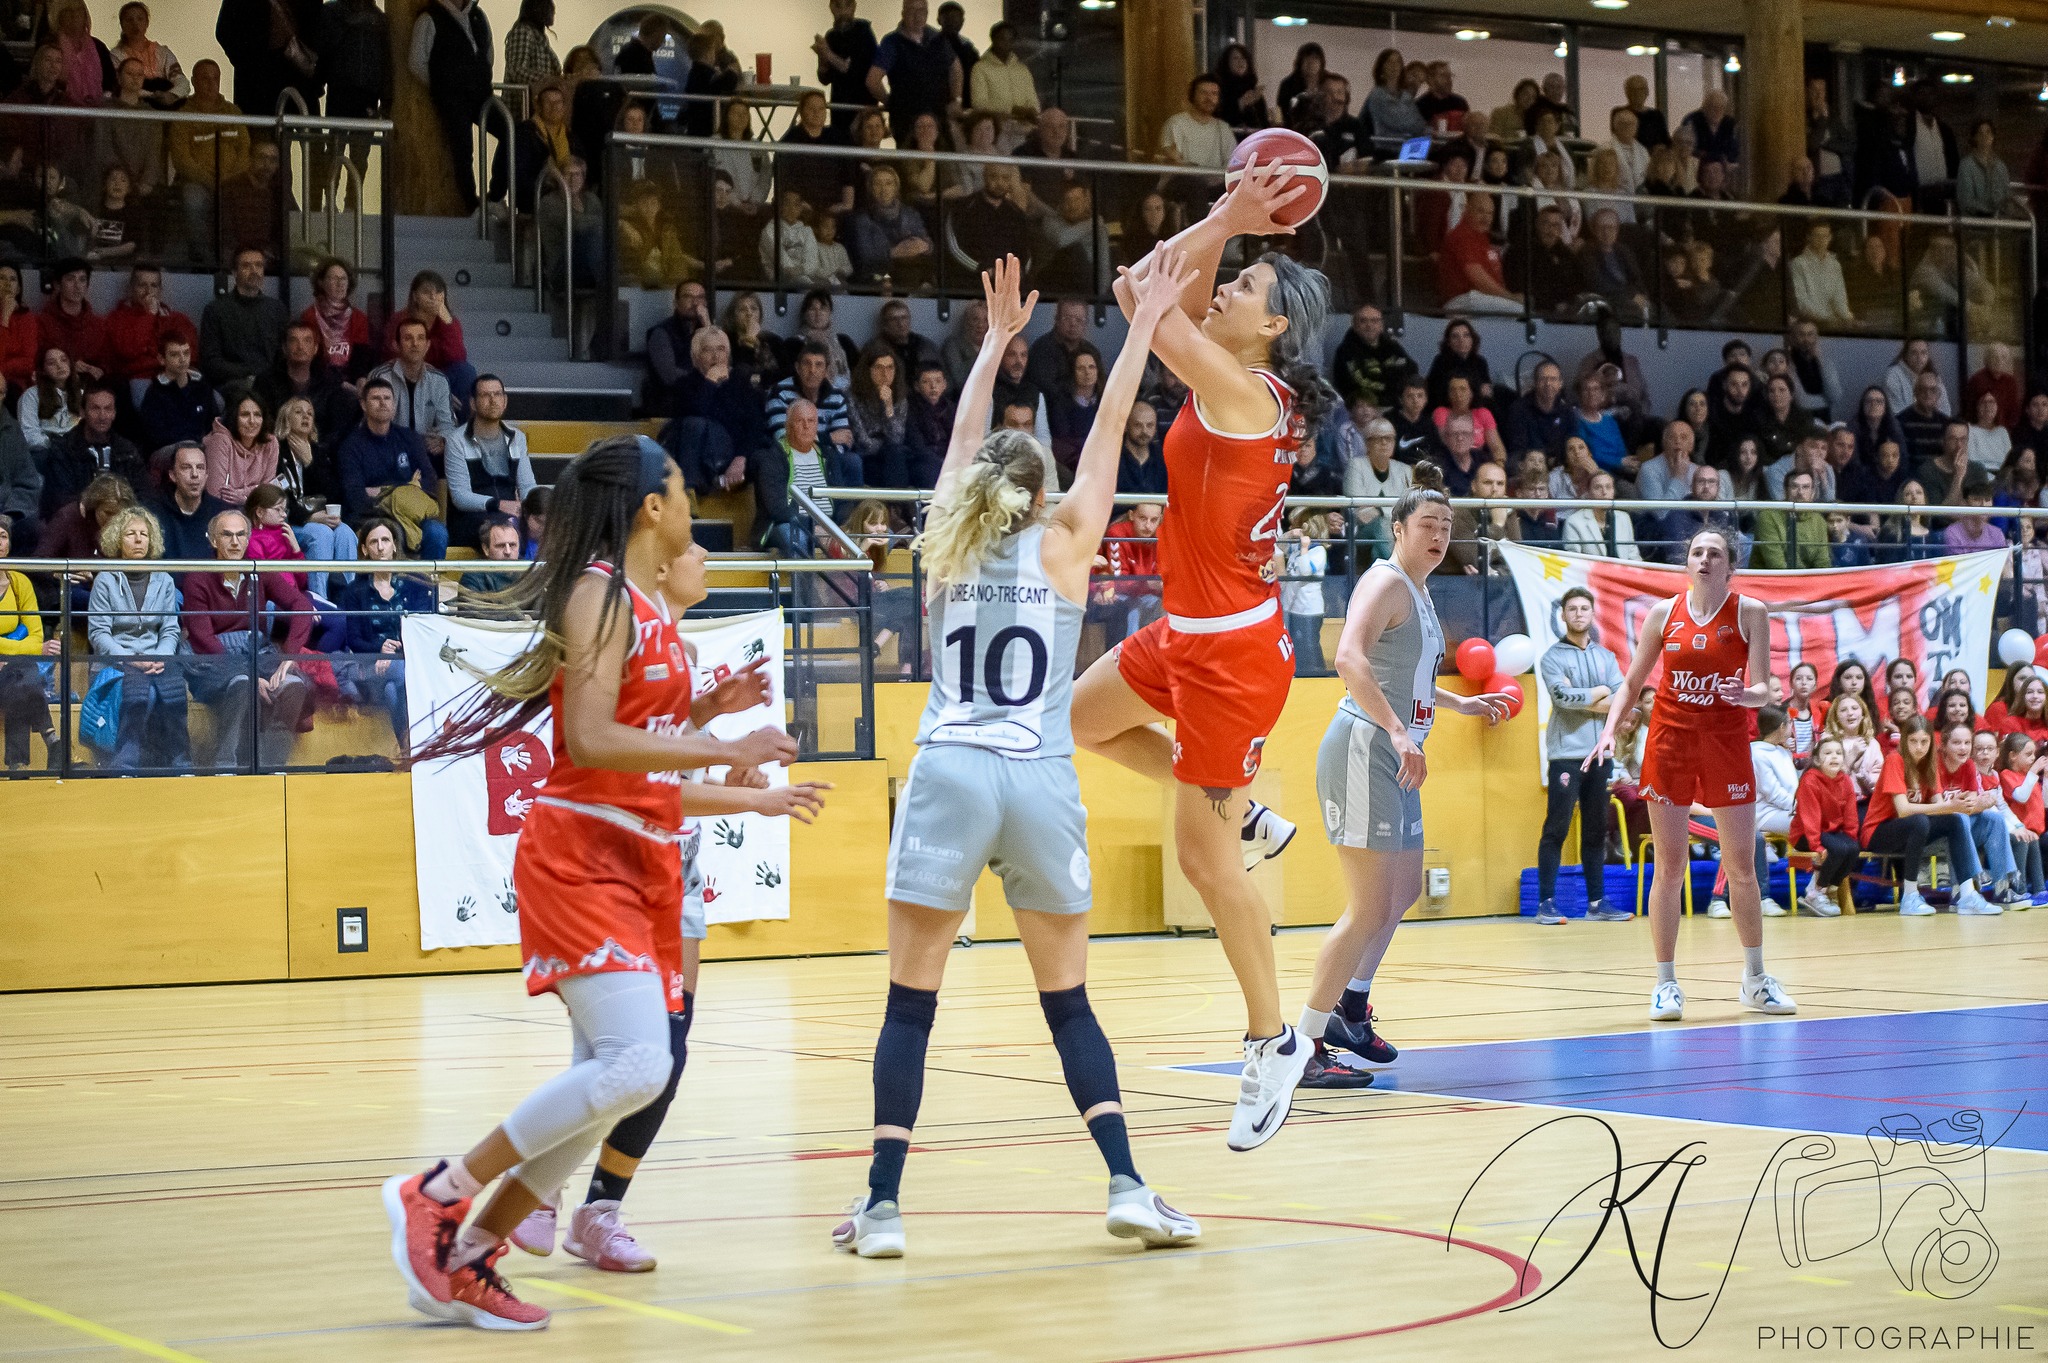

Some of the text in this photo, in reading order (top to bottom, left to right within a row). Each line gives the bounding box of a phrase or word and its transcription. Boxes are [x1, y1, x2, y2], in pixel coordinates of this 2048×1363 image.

[1250, 482, 1287, 541] 2
[951, 583, 1048, 604] DREANO-TRECANT
[1667, 621, 1685, 638] 7
[945, 625, 1048, 706] 10
[1671, 670, 1725, 692] Work
[1678, 693, 1715, 706] 2000
[1727, 783, 1750, 792] Work
